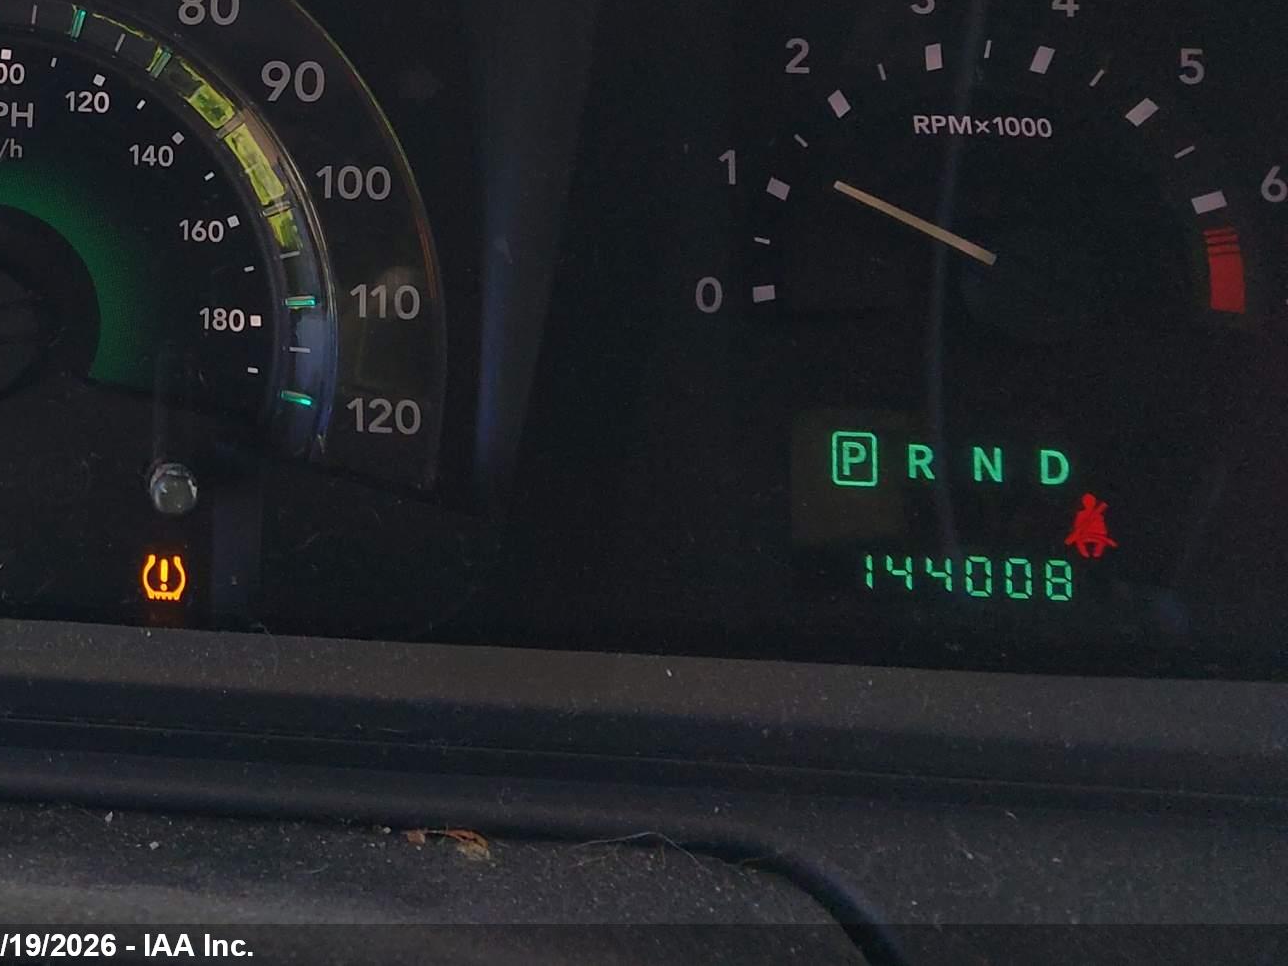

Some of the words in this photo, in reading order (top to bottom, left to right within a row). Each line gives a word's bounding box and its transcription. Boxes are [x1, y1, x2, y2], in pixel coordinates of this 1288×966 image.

[786, 38, 809, 73] 2
[1179, 48, 1204, 84] 5
[262, 61, 324, 101] 90
[66, 92, 109, 113] 120
[130, 145, 173, 166] 140
[719, 150, 735, 184] 1
[316, 166, 390, 199] 100
[1261, 166, 1287, 202] 6
[180, 220, 223, 242] 160
[350, 285, 419, 319] 110
[696, 277, 722, 312] 0
[200, 308, 244, 331] 180
[347, 398, 420, 434] 120
[843, 442, 866, 475] P
[909, 444, 934, 479] R
[974, 447, 1002, 482] N
[1041, 450, 1069, 484] D
[866, 555, 1072, 600] 144008
